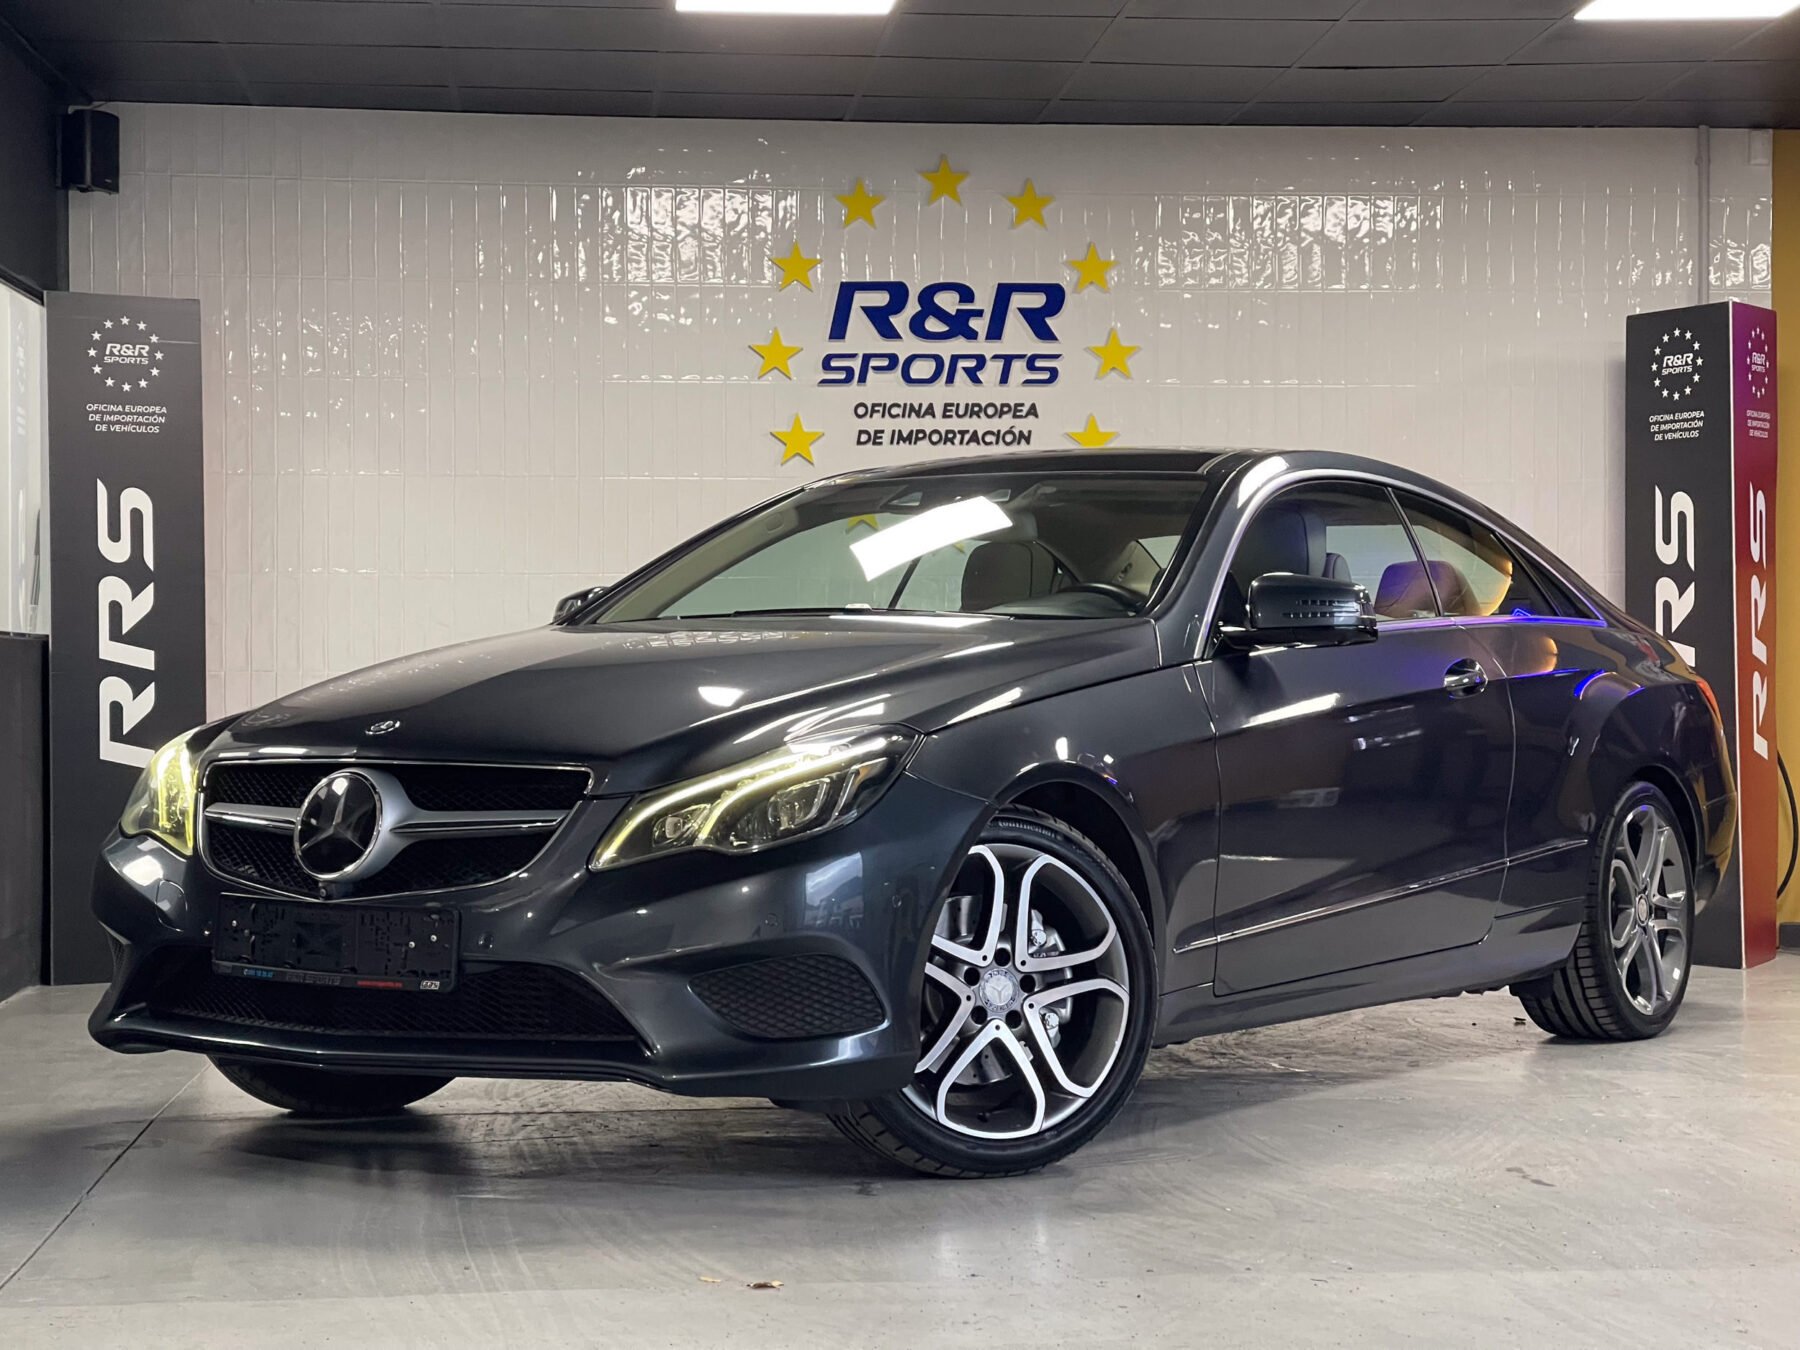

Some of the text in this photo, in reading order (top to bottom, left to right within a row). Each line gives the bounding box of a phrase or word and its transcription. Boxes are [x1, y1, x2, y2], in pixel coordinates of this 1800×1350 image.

[828, 281, 1066, 342] R&R
[105, 343, 149, 356] R&R
[103, 356, 149, 365] SPORTS
[1663, 353, 1694, 367] R&R
[817, 352, 1063, 387] SPORTS
[1661, 365, 1693, 376] SPORTS
[86, 403, 167, 413] OFICINA EUROPEA
[853, 402, 1039, 419] OFICINA EUROPEA
[88, 413, 165, 423] DE IMPORTACIÓN
[1649, 410, 1705, 423] OFICINA EUROPEA
[95, 423, 160, 433] DE VEHÍCULOS
[1650, 419, 1704, 432] DE IMPORTACIÓN
[856, 425, 1032, 446] DE IMPORTACIÓN
[1654, 429, 1700, 441] DE VEHÍCULOS
[1655, 485, 1695, 667] RS
[97, 478, 155, 768] RRS
[1749, 481, 1769, 761] RRS
